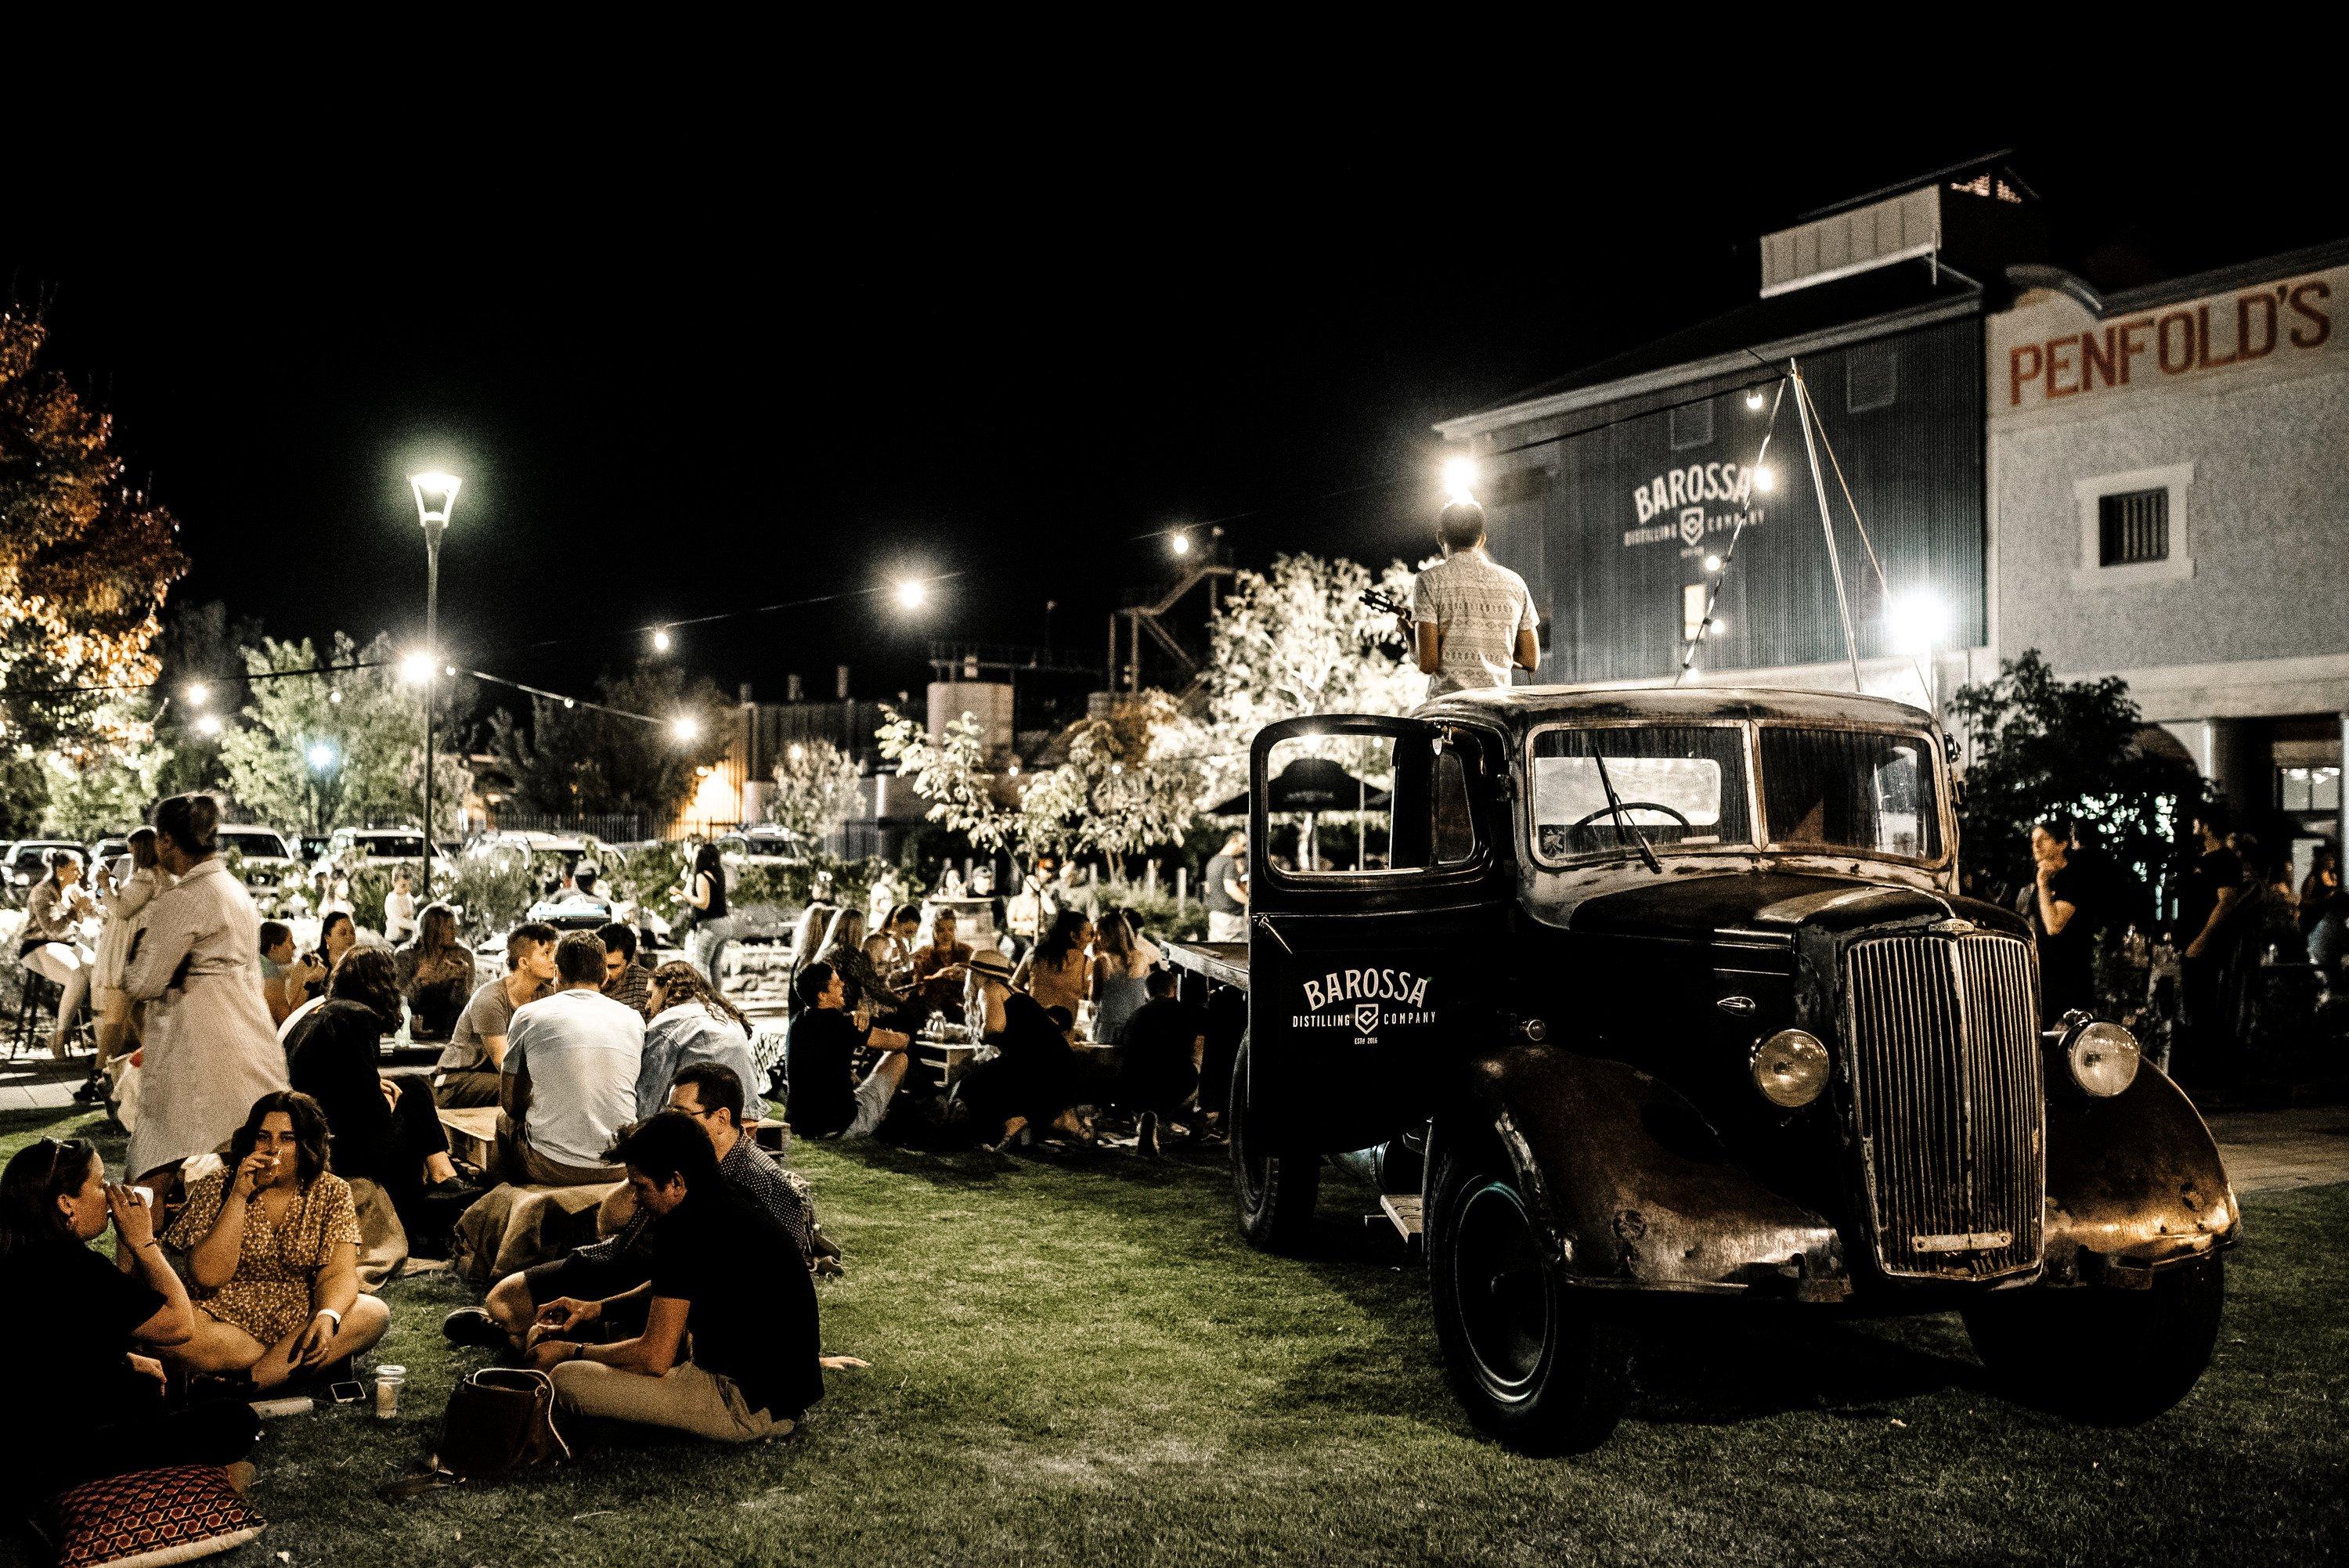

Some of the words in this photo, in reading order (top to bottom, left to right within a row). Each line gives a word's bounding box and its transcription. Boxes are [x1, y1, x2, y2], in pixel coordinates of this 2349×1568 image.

[2009, 280, 2332, 406] PENFOLD'S
[1633, 462, 1752, 524] BAROSSA
[1303, 968, 1427, 1011] BAROSSA
[1293, 1015, 1350, 1028] DISTILLING
[1384, 1011, 1436, 1025] COMPANY
